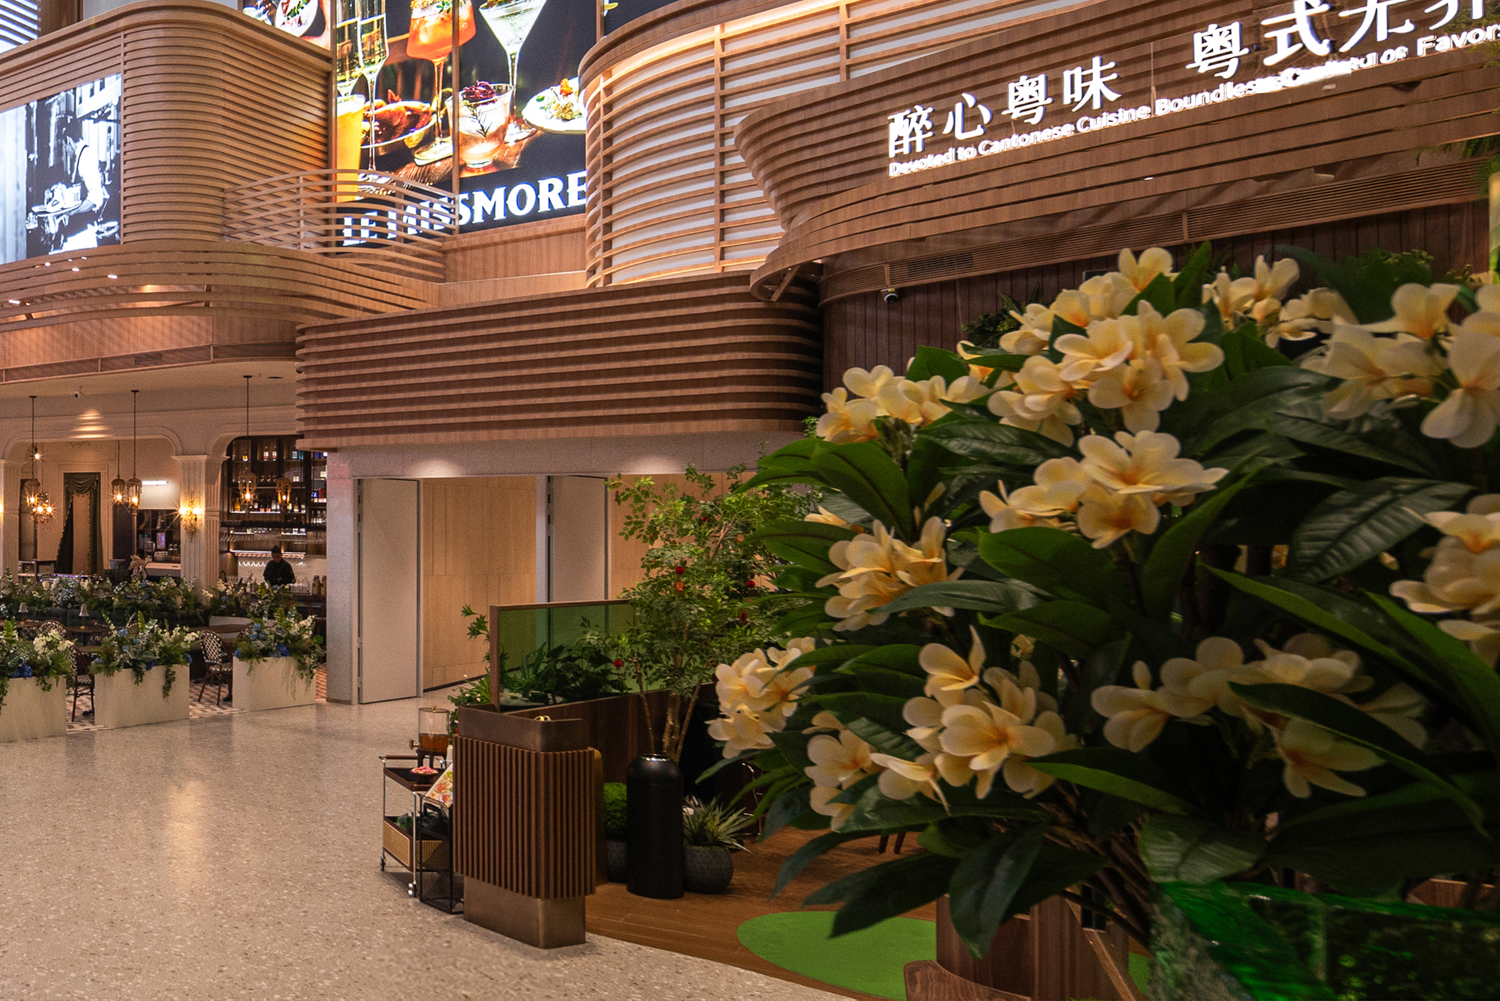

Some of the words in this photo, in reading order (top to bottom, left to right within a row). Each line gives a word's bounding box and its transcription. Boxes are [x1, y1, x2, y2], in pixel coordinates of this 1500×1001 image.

[887, 55, 1122, 158] 醉心粤味
[889, 146, 956, 177] Devoted
[956, 145, 977, 161] to
[978, 121, 1075, 155] Cantonese
[1076, 104, 1151, 133] Cuisine
